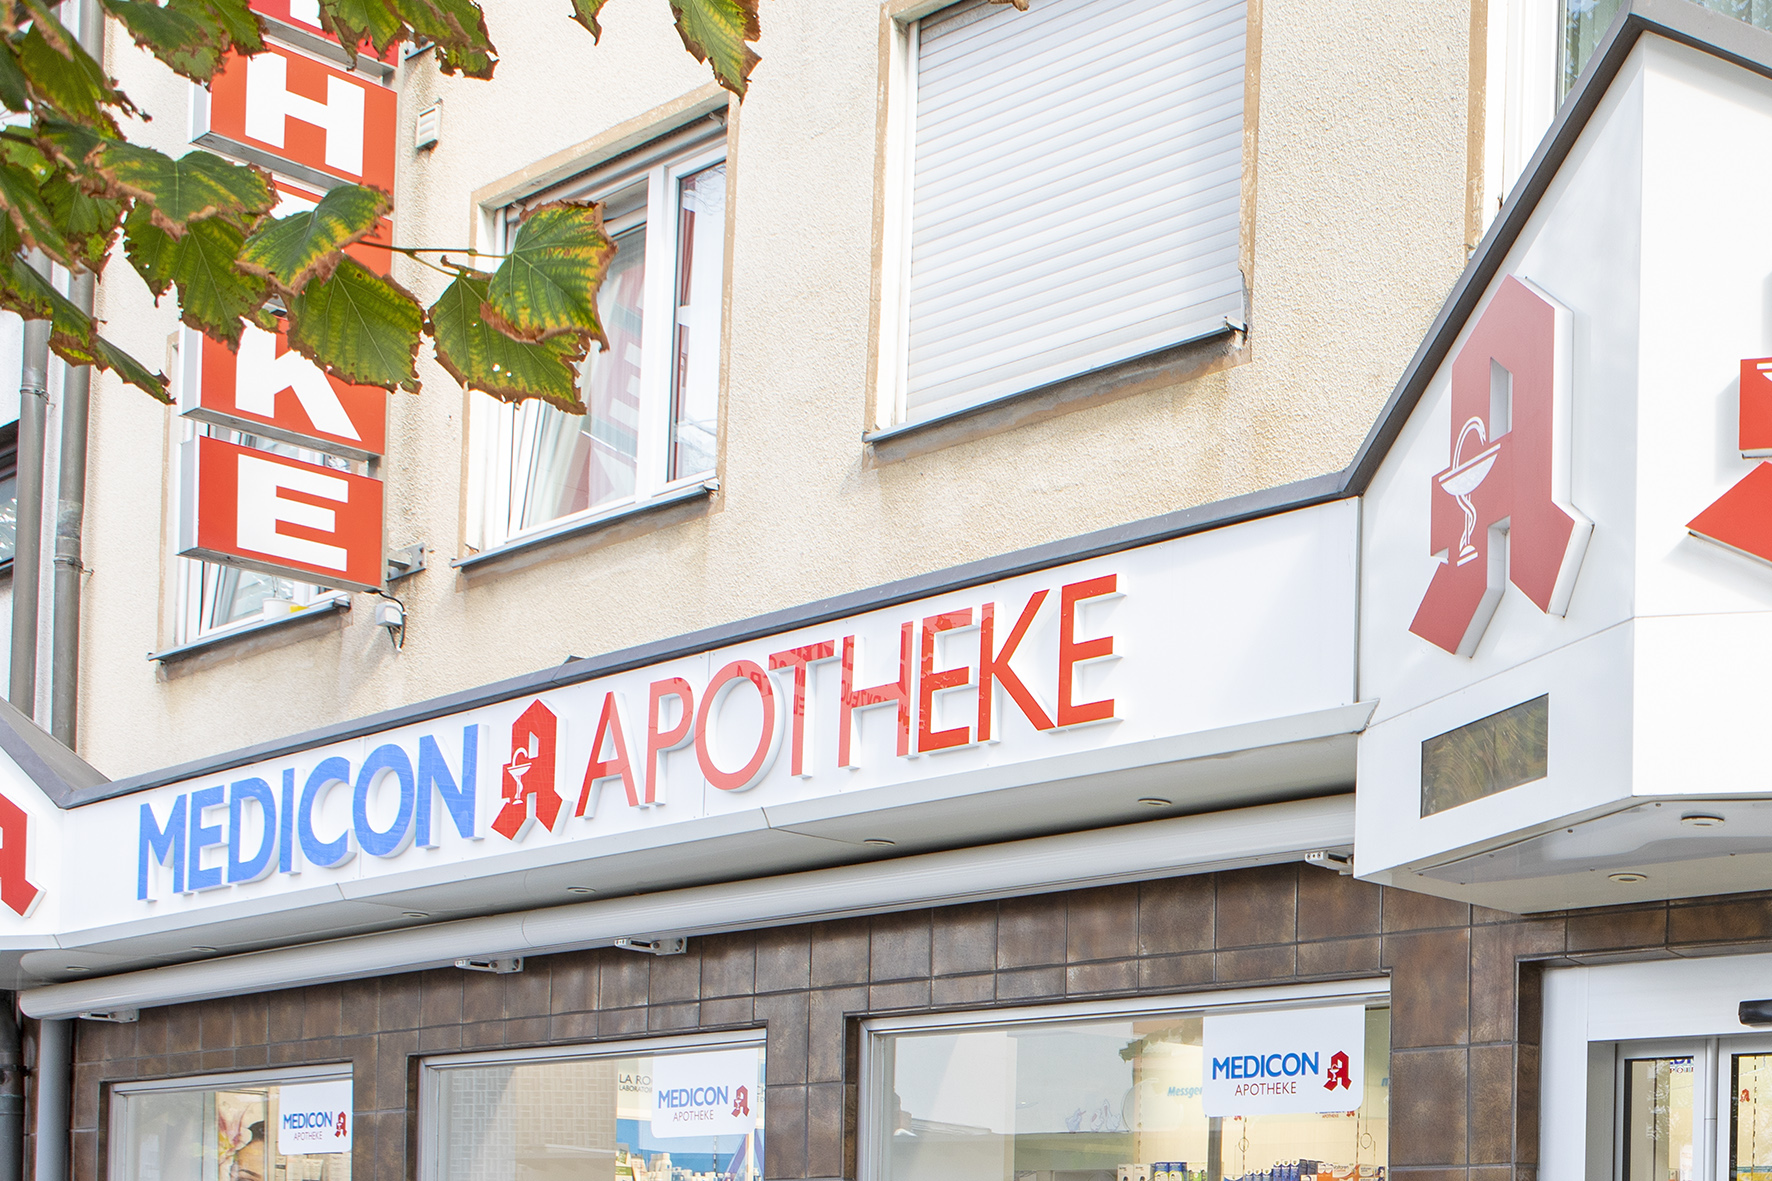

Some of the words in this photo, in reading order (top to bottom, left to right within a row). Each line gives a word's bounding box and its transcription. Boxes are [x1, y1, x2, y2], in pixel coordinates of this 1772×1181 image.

[138, 724, 481, 900] MEDICON
[575, 574, 1118, 818] APOTHEKE
[1212, 1051, 1319, 1080] MEDICON
[658, 1086, 729, 1109] MEDICON
[1234, 1082, 1297, 1097] APOTHEKE
[283, 1111, 333, 1130] MEDICON
[673, 1109, 714, 1122] APOTHEKE
[293, 1131, 323, 1141] APOTHEKE
